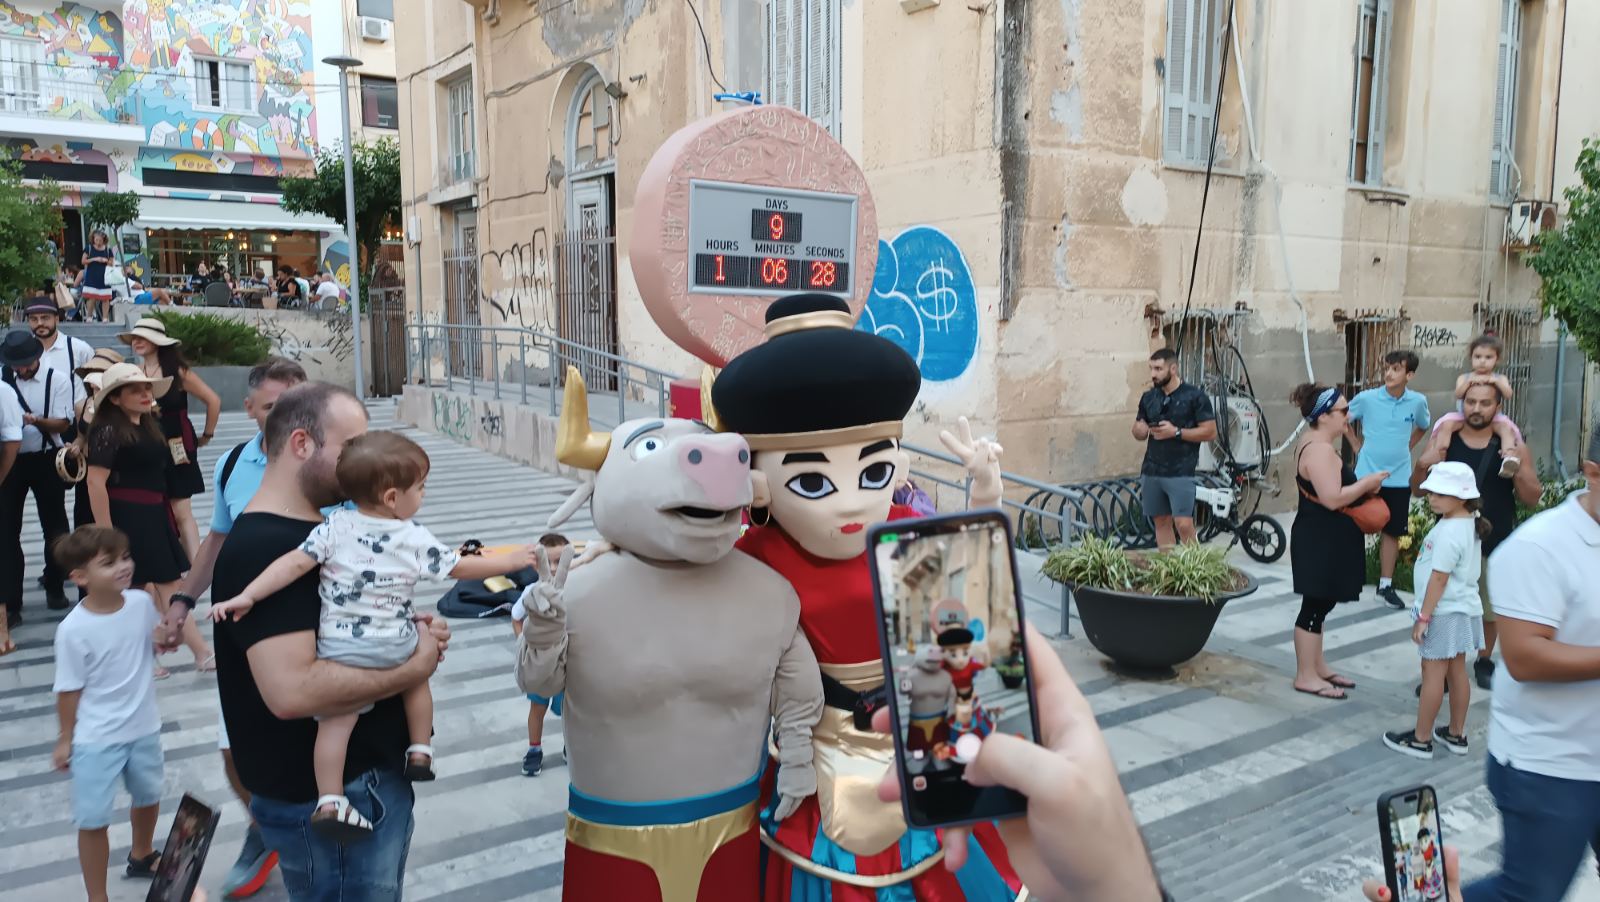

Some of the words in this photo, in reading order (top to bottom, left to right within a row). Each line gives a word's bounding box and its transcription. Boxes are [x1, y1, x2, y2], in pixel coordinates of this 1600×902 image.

[765, 198, 788, 210] DAYS
[770, 214, 784, 240] 9
[706, 239, 739, 251] HOURS
[755, 243, 795, 255] MINUTES
[805, 246, 845, 259] SECONDS
[715, 255, 725, 281] 1
[762, 258, 788, 284] 06
[811, 261, 836, 287] 28
